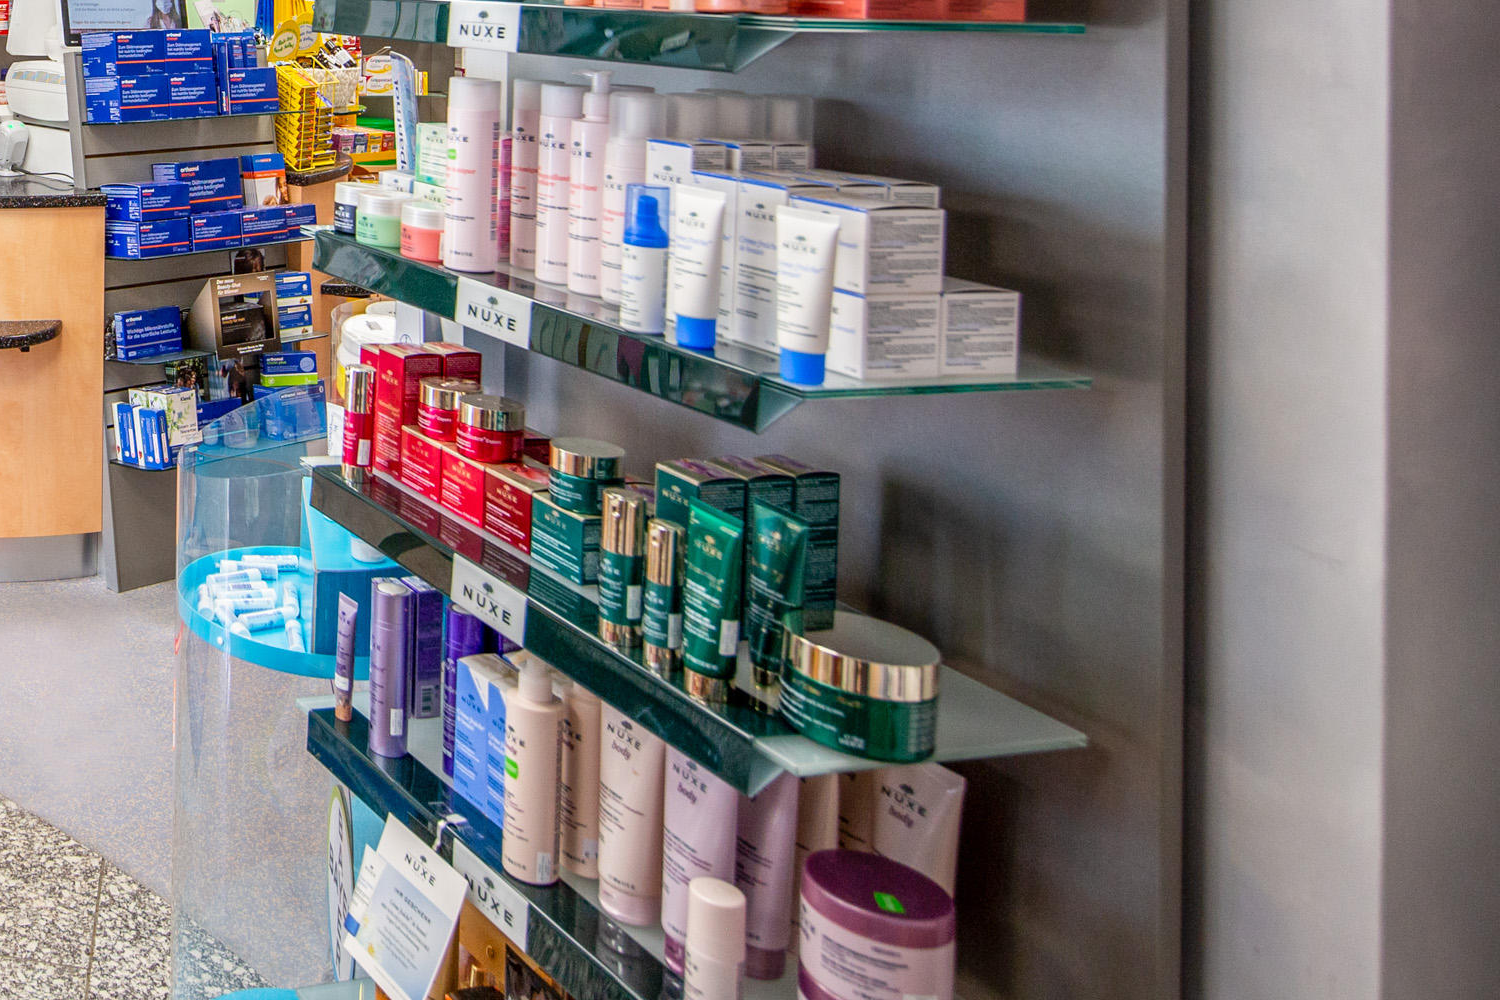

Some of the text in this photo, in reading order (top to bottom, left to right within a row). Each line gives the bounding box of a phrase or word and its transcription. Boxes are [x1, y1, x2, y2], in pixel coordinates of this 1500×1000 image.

[459, 23, 506, 39] NUXE
[467, 303, 517, 331] NUXE
[463, 584, 512, 626] NUXE
[607, 723, 641, 751] NUXE
[611, 740, 631, 761] body
[880, 785, 927, 817] NUXE
[404, 853, 436, 887] NUXE
[465, 872, 514, 927] NUXE
